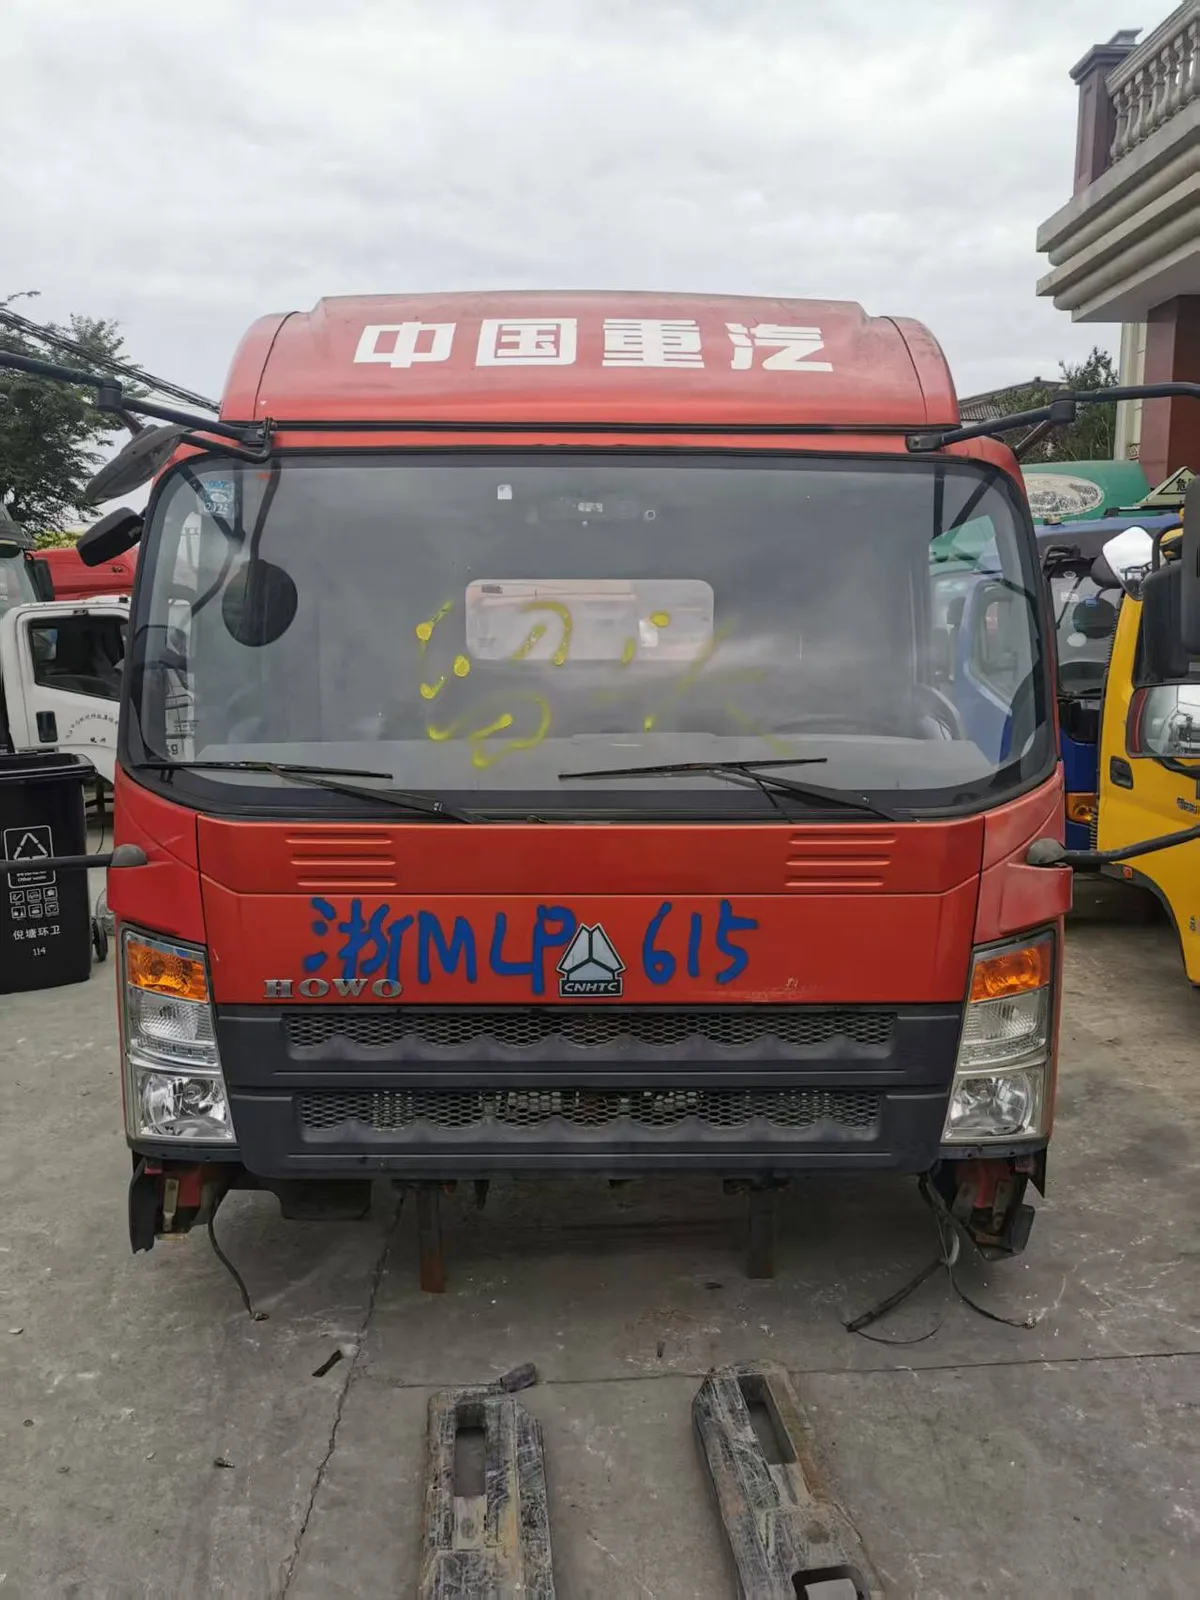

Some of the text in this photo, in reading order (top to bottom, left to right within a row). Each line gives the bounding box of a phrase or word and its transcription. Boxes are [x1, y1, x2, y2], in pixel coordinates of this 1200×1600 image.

[353, 318, 834, 372] 中国重汽
[263, 978, 403, 998] HOWO
[564, 982, 618, 992] CNHTC
